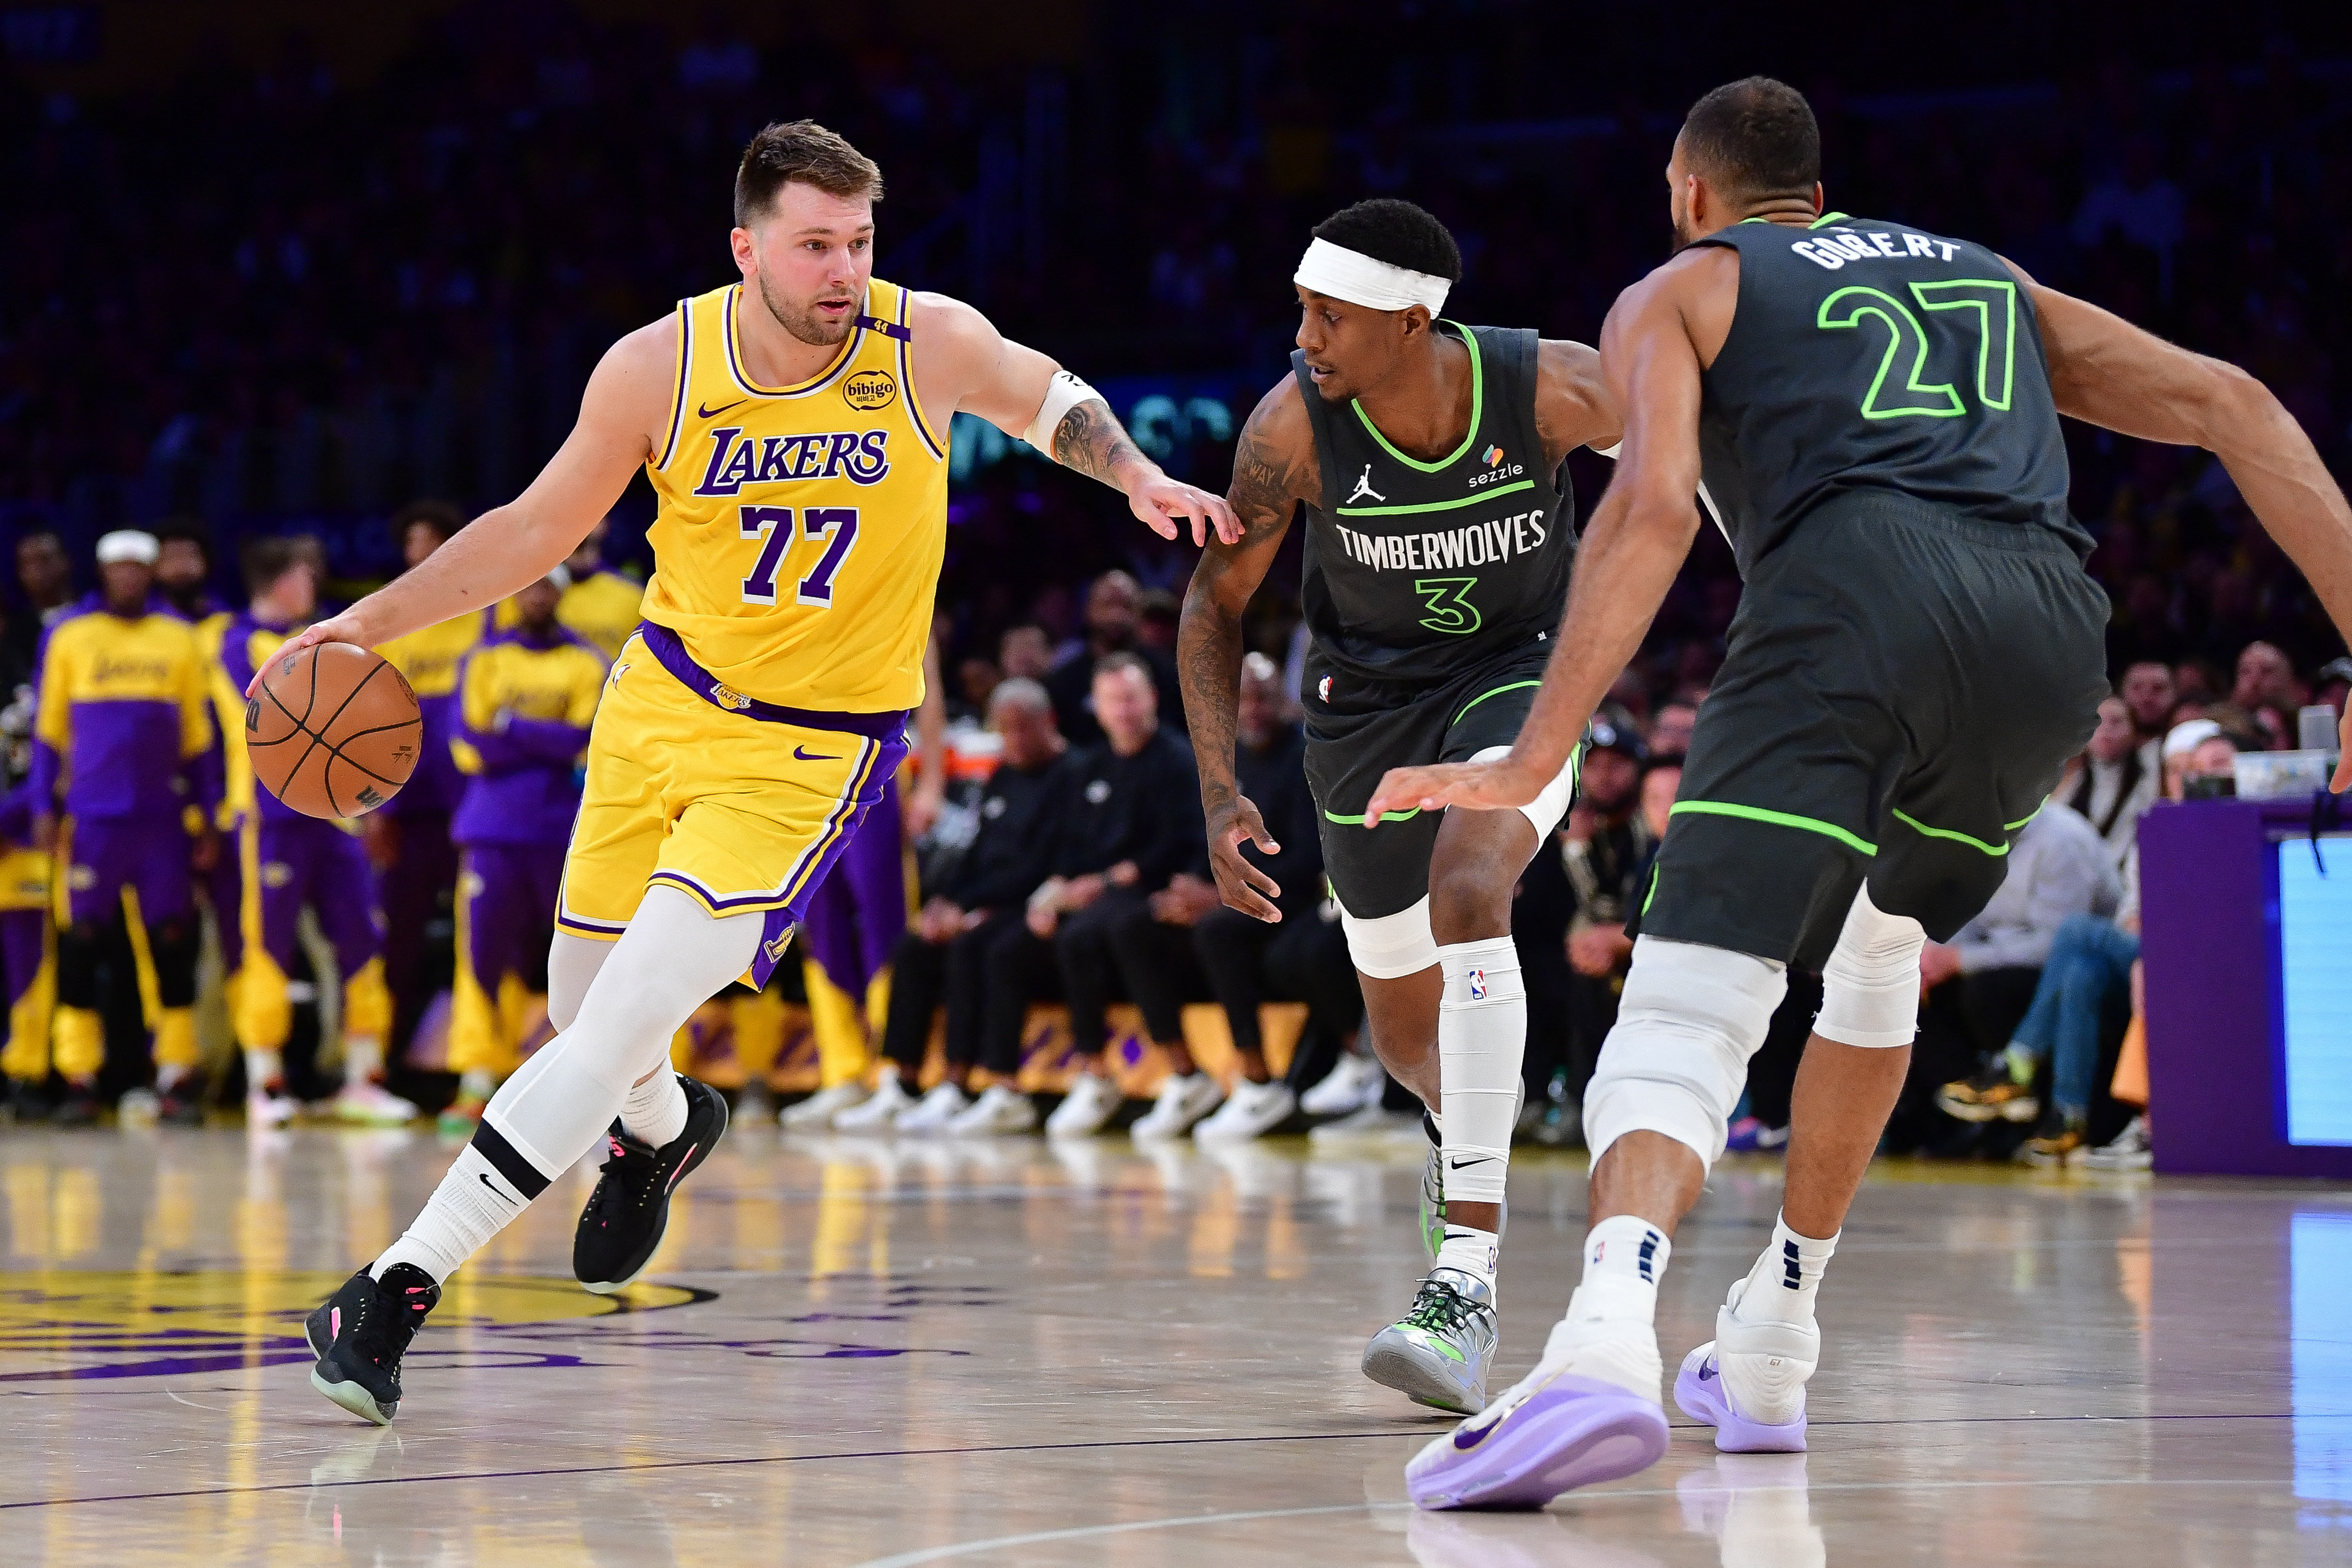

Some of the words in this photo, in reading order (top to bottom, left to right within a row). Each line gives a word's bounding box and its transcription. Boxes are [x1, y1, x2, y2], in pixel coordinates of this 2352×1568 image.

[1791, 232, 1960, 270] GOBERT
[874, 319, 889, 334] 44
[1817, 279, 2016, 419] 27
[847, 381, 893, 398] bibigo
[692, 426, 891, 497] LAKERS
[1469, 463, 1523, 487] sezzle
[738, 504, 860, 609] 77
[1336, 509, 1546, 572] TIMBERWOLVES
[1415, 577, 1482, 633] 3
